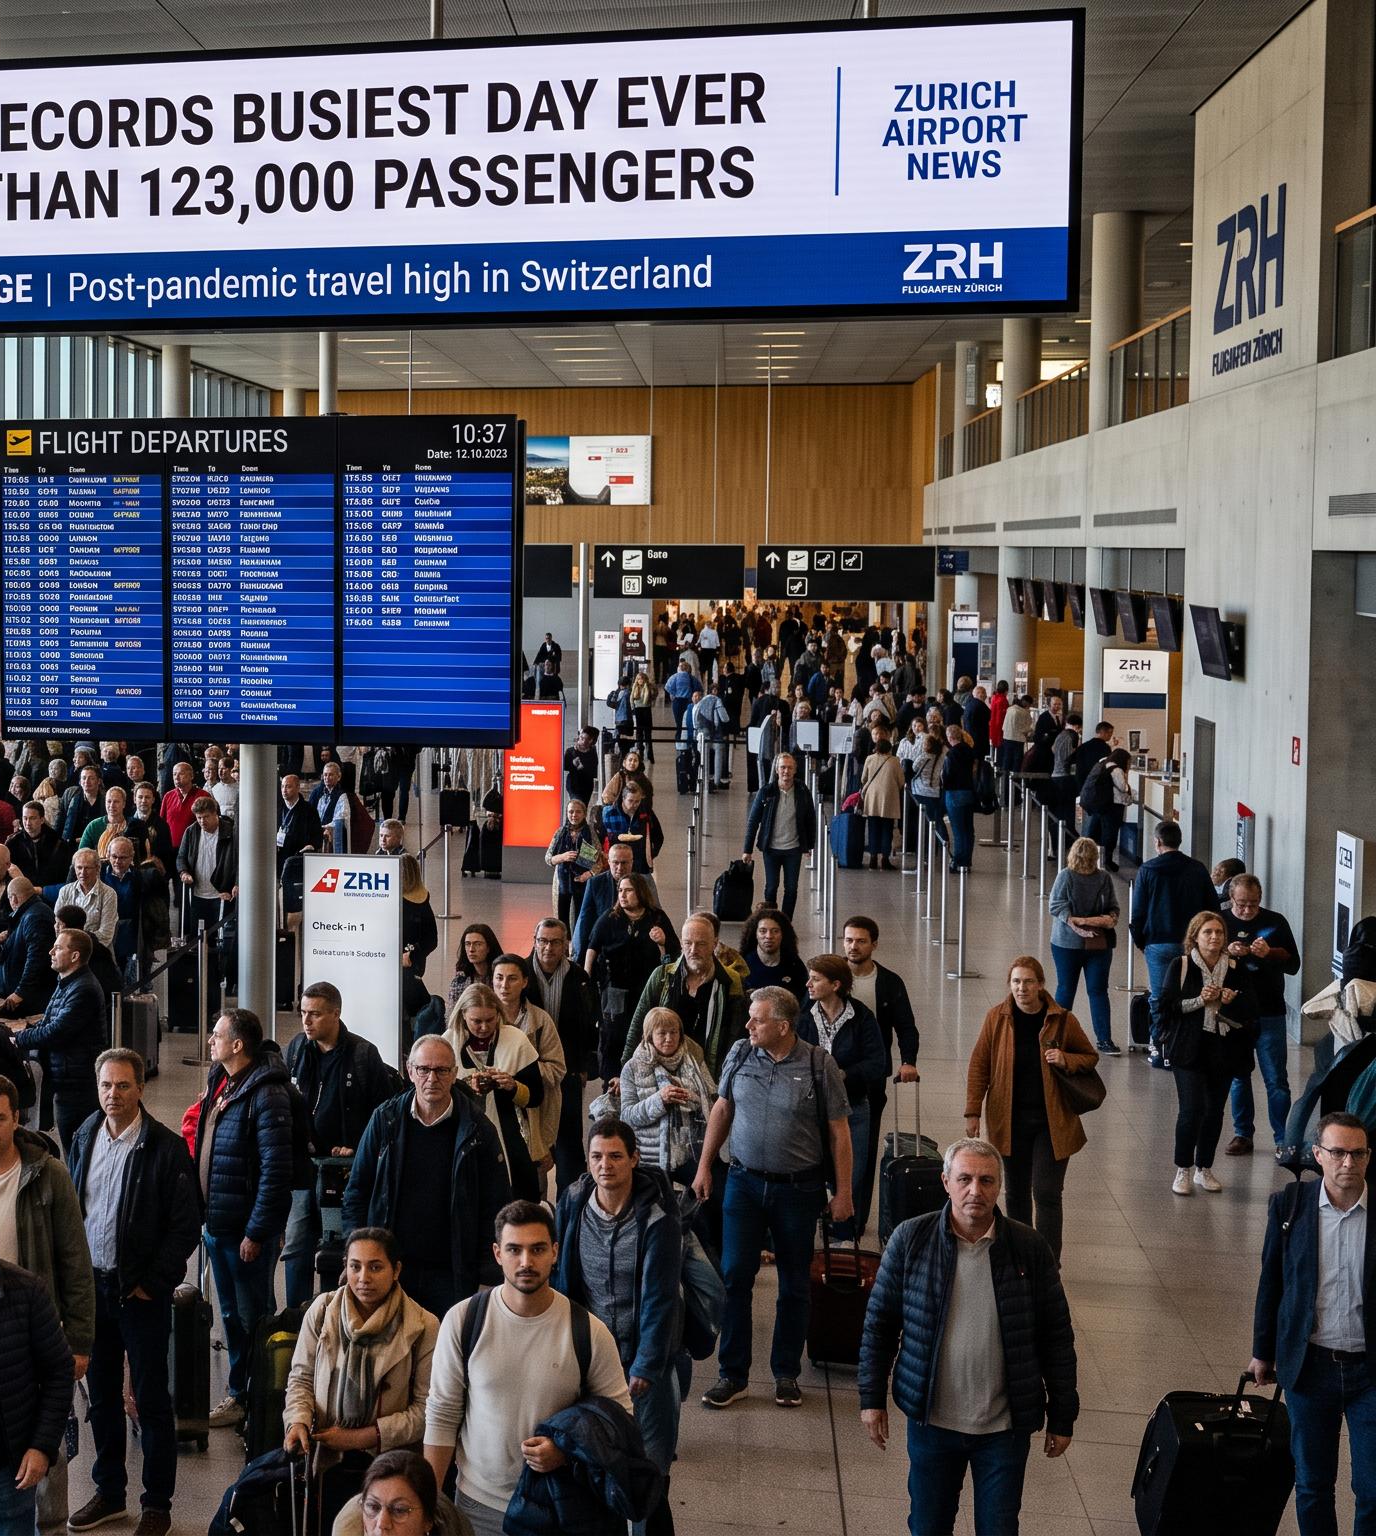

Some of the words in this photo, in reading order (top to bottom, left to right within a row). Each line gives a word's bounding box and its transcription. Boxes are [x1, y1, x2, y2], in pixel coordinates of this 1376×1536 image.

[233, 83, 469, 144] BUSIEST
[487, 78, 599, 134] DAY
[617, 72, 766, 129] EVER
[894, 79, 1016, 113] ZURICH
[881, 113, 1029, 147] AIRPORT
[907, 149, 1002, 181] NEWS
[140, 160, 354, 225] 123,000
[374, 145, 755, 210] PASSENGERS
[902, 241, 1003, 281] ZRH
[1213, 183, 1287, 336] ZRH
[69, 266, 297, 308] Post-pandemic
[305, 263, 392, 297] travel
[404, 261, 470, 302] high
[483, 261, 509, 293] in
[520, 254, 712, 292] Switzerland
[964, 282, 1003, 293] ZÜRICH
[39, 430, 123, 455] FLIGHT
[131, 428, 288, 454] DEPARTURES
[452, 423, 507, 444] 10:37
[427, 449, 453, 459] Date:
[455, 448, 508, 459] 12.10.2023
[1119, 659, 1152, 671] ZRH
[343, 871, 390, 891] ZRH
[312, 921, 357, 932] Check-in
[359, 923, 365, 931] 1
